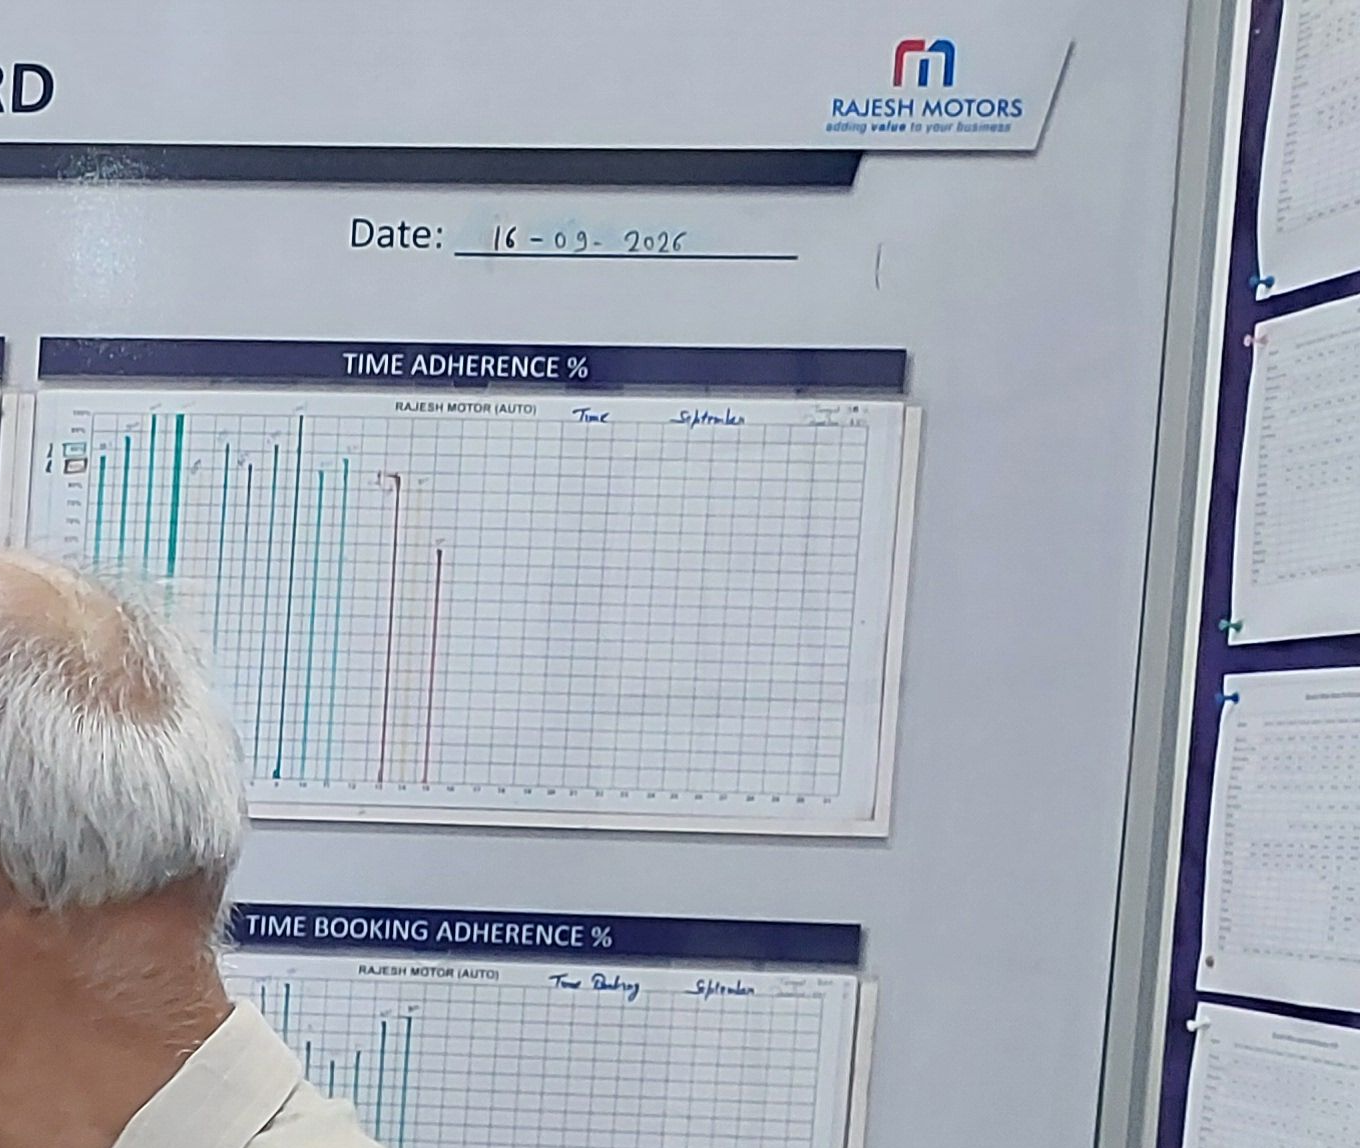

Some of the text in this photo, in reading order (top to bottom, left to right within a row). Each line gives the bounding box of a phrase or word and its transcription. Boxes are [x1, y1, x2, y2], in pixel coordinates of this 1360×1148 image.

[832, 98, 1023, 118] RAJESH MOTORS
[826, 121, 1012, 134] adding value to your business
[350, 218, 444, 249] Date:
[343, 352, 589, 379] TIME ADHERENCE %
[395, 401, 444, 412] RAJESH
[447, 402, 491, 414] MOTOR
[494, 403, 537, 416] (AUTO)
[246, 914, 613, 948] TIME BOOKING ADHERENCE %
[359, 965, 407, 976] RAJESH
[411, 966, 455, 978] MOTOR
[457, 967, 500, 980] (AUTO)
